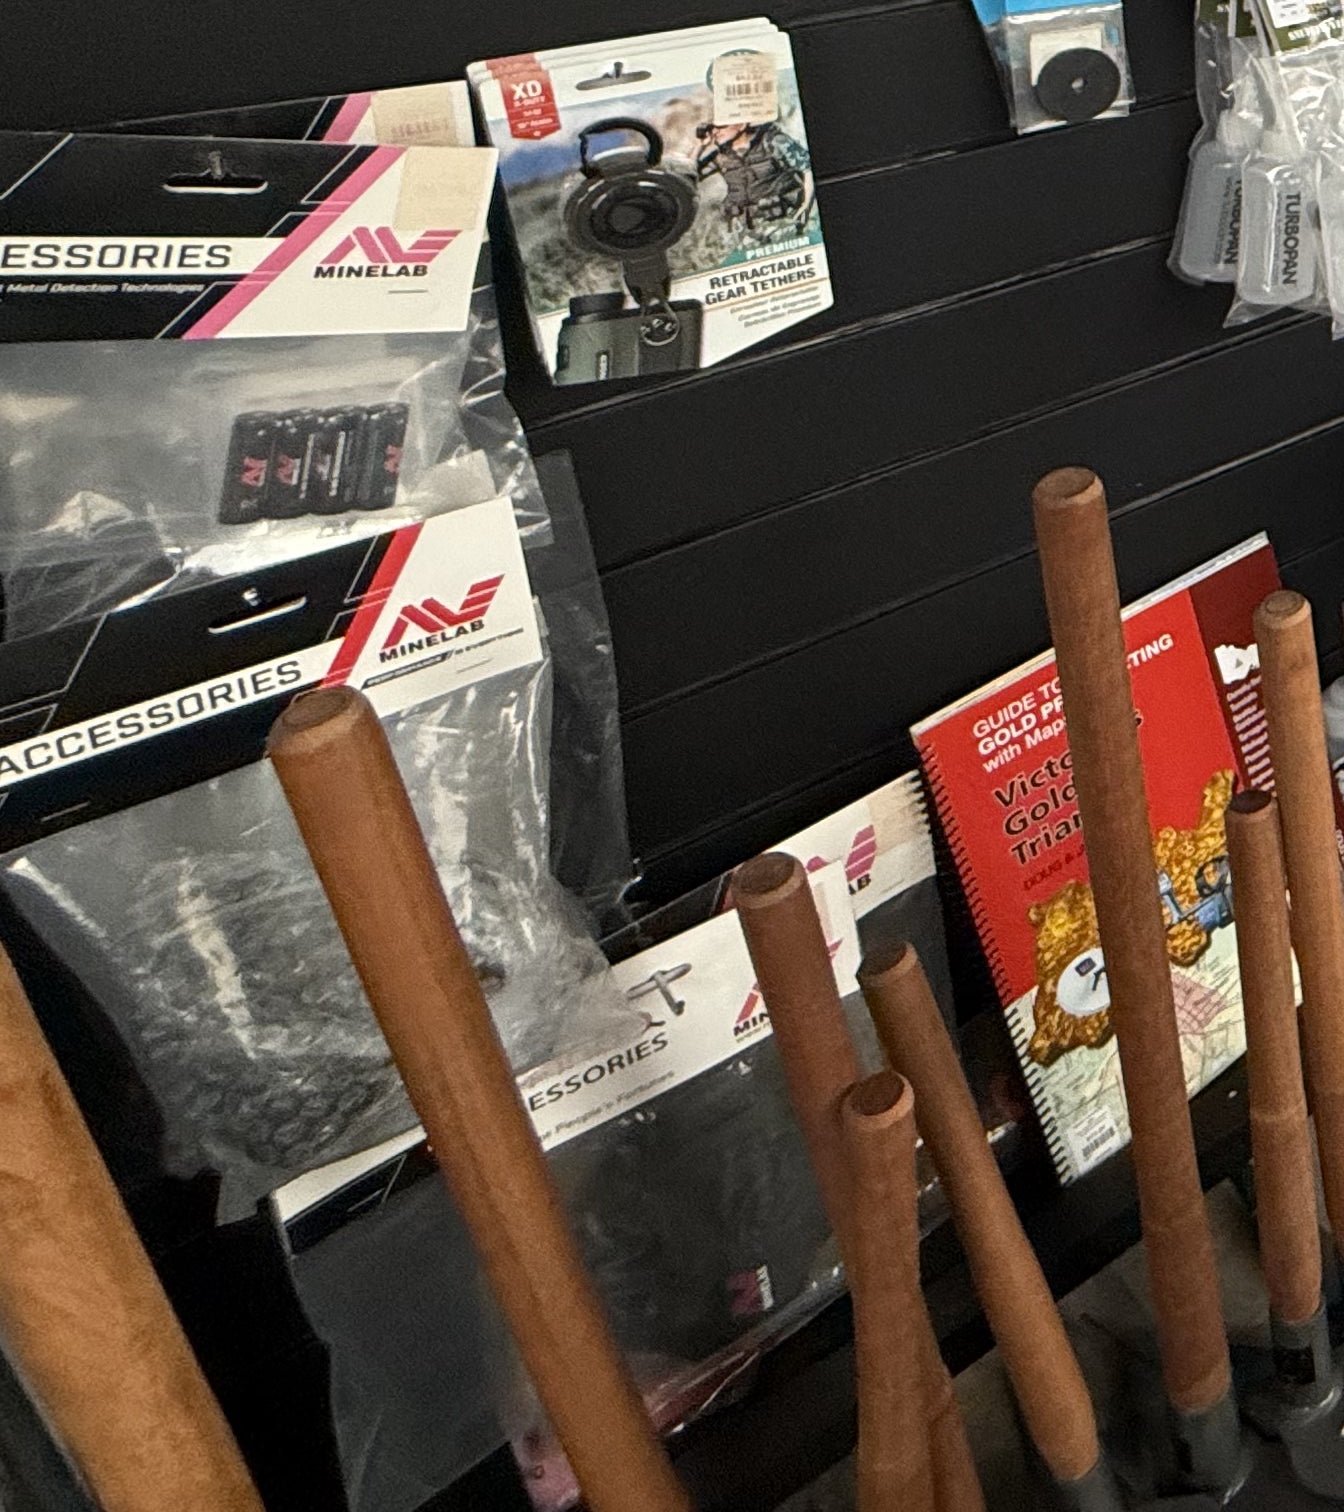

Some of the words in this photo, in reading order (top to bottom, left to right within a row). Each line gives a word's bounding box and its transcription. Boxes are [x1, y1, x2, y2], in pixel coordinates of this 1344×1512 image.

[0, 243, 234, 270] ESSORIES
[745, 236, 810, 260] PREMIUM
[1282, 192, 1300, 285] TURBOPAN
[313, 264, 429, 280] MINELAB
[704, 285, 747, 306] GEAR
[750, 267, 817, 293] TETHERS
[709, 253, 815, 290] RETRACTABLE
[379, 619, 485, 664] MINELAB
[0, 660, 303, 779] ACCESSORIES
[972, 692, 1038, 739] GUIDE
[977, 713, 1038, 757] GOLD
[982, 743, 1023, 774] with
[1003, 774, 1080, 836] Gold
[528, 1030, 669, 1113] ESSORIES
